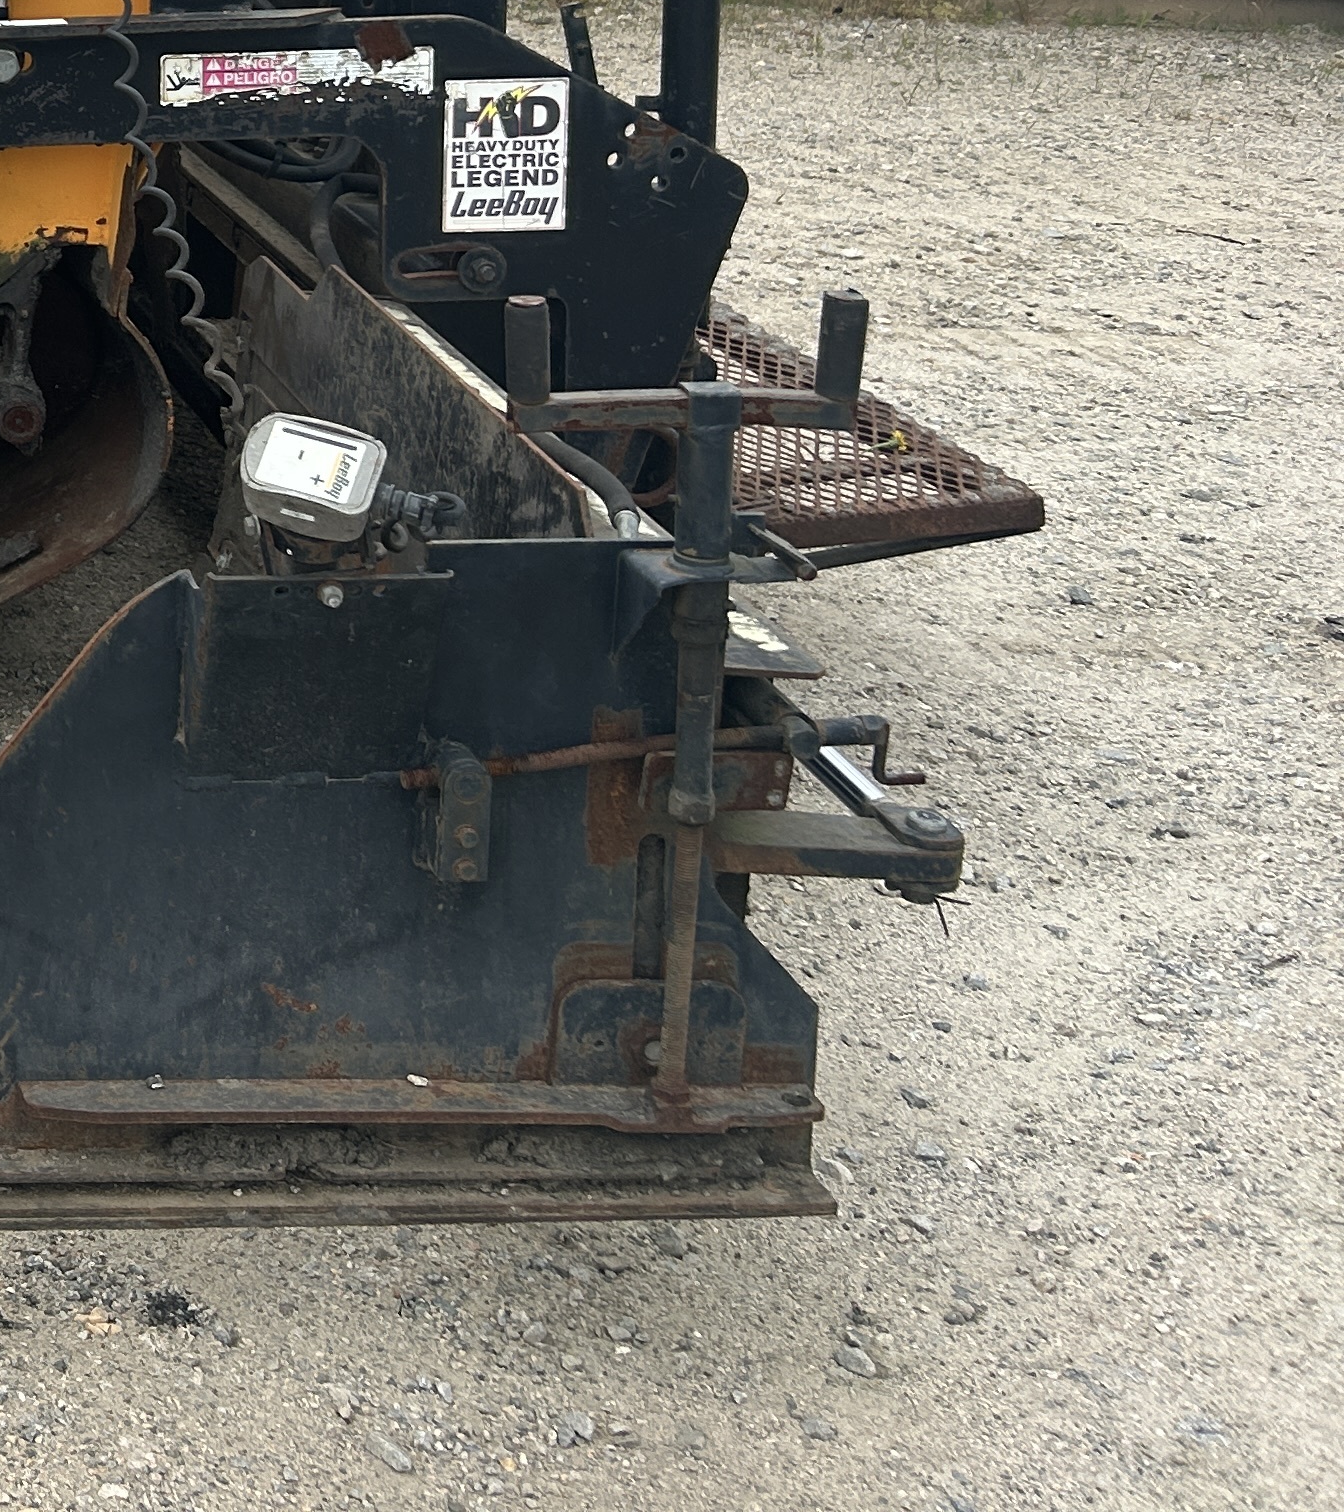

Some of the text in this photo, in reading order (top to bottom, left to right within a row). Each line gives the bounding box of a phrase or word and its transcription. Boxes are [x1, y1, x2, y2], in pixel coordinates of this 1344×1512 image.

[224, 57, 284, 71] DANGE
[223, 71, 293, 85] PELIGRO
[452, 139, 560, 153] HEAVY DUTY
[451, 152, 560, 169] ELECTRIC
[451, 169, 559, 188] LEGEND
[450, 189, 559, 225] LeeBoy
[324, 452, 358, 500] LeeBoy
